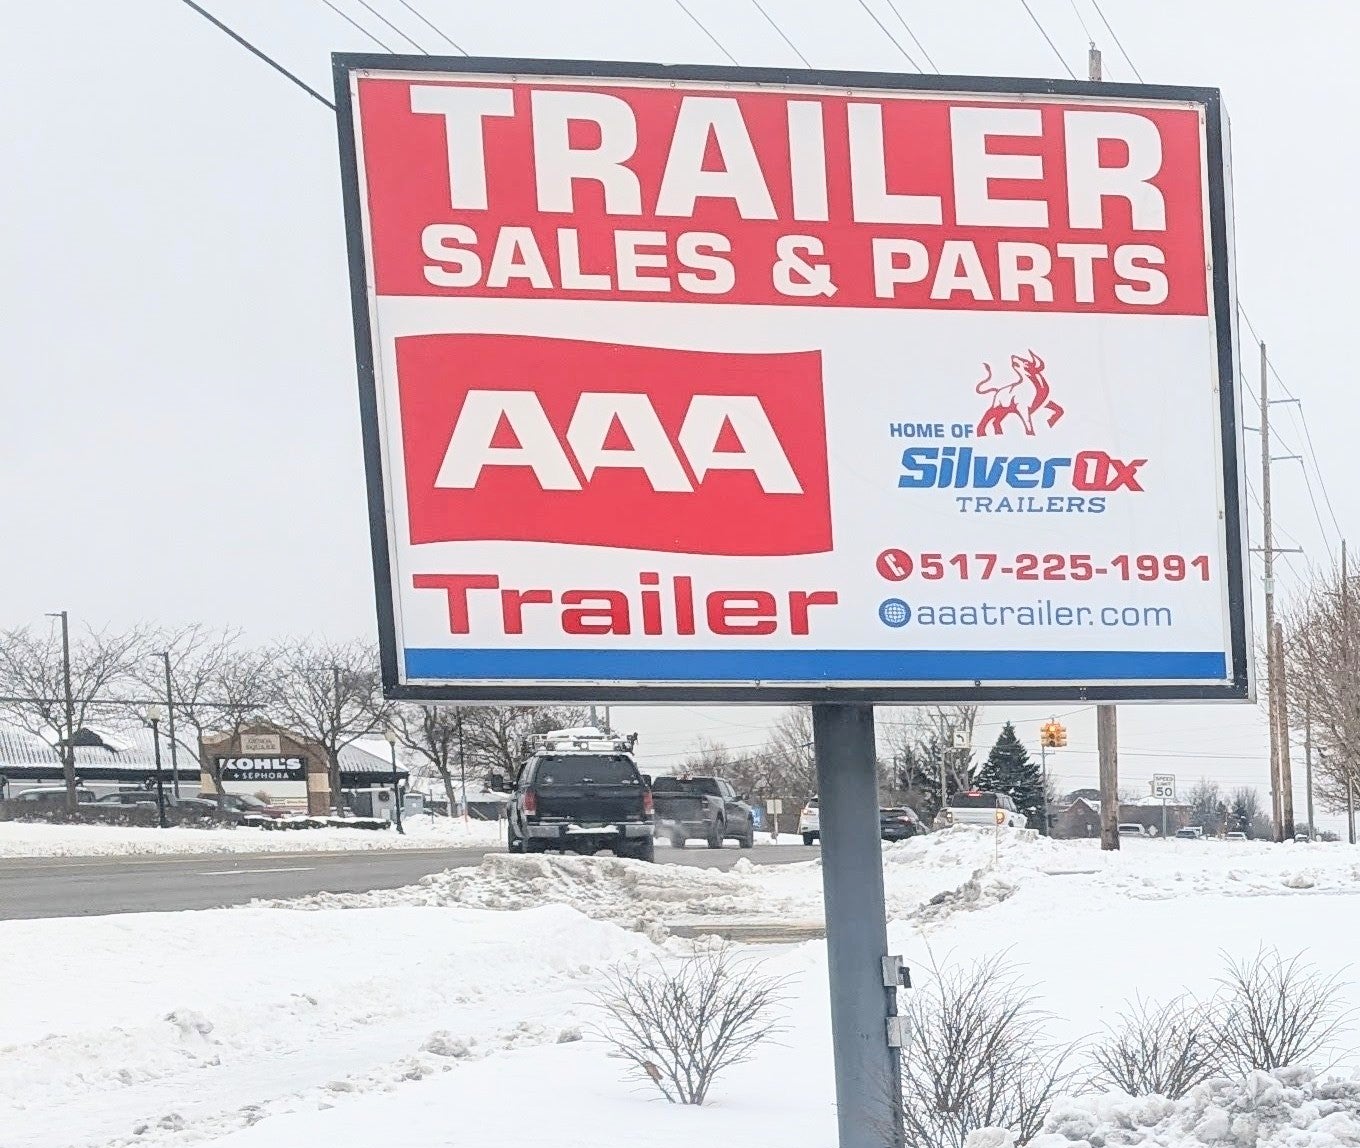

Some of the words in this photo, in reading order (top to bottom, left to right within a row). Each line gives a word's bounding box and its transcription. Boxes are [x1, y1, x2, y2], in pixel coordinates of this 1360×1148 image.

[410, 83, 1168, 232] TRAILER
[419, 223, 737, 296] SALES
[773, 235, 839, 298] &
[872, 237, 1170, 306] PARTS
[433, 389, 804, 494] AAA
[890, 423, 945, 438] HOME
[951, 424, 974, 438] OF
[955, 496, 1107, 514] TRAILERS
[920, 553, 1211, 582] 517-225-1991
[412, 572, 838, 636] Trailer
[917, 600, 1172, 627] aaatrailer.com
[219, 758, 301, 770] KOHL'S
[242, 772, 289, 780] SEPHORA
[1156, 787, 1173, 797] 50
